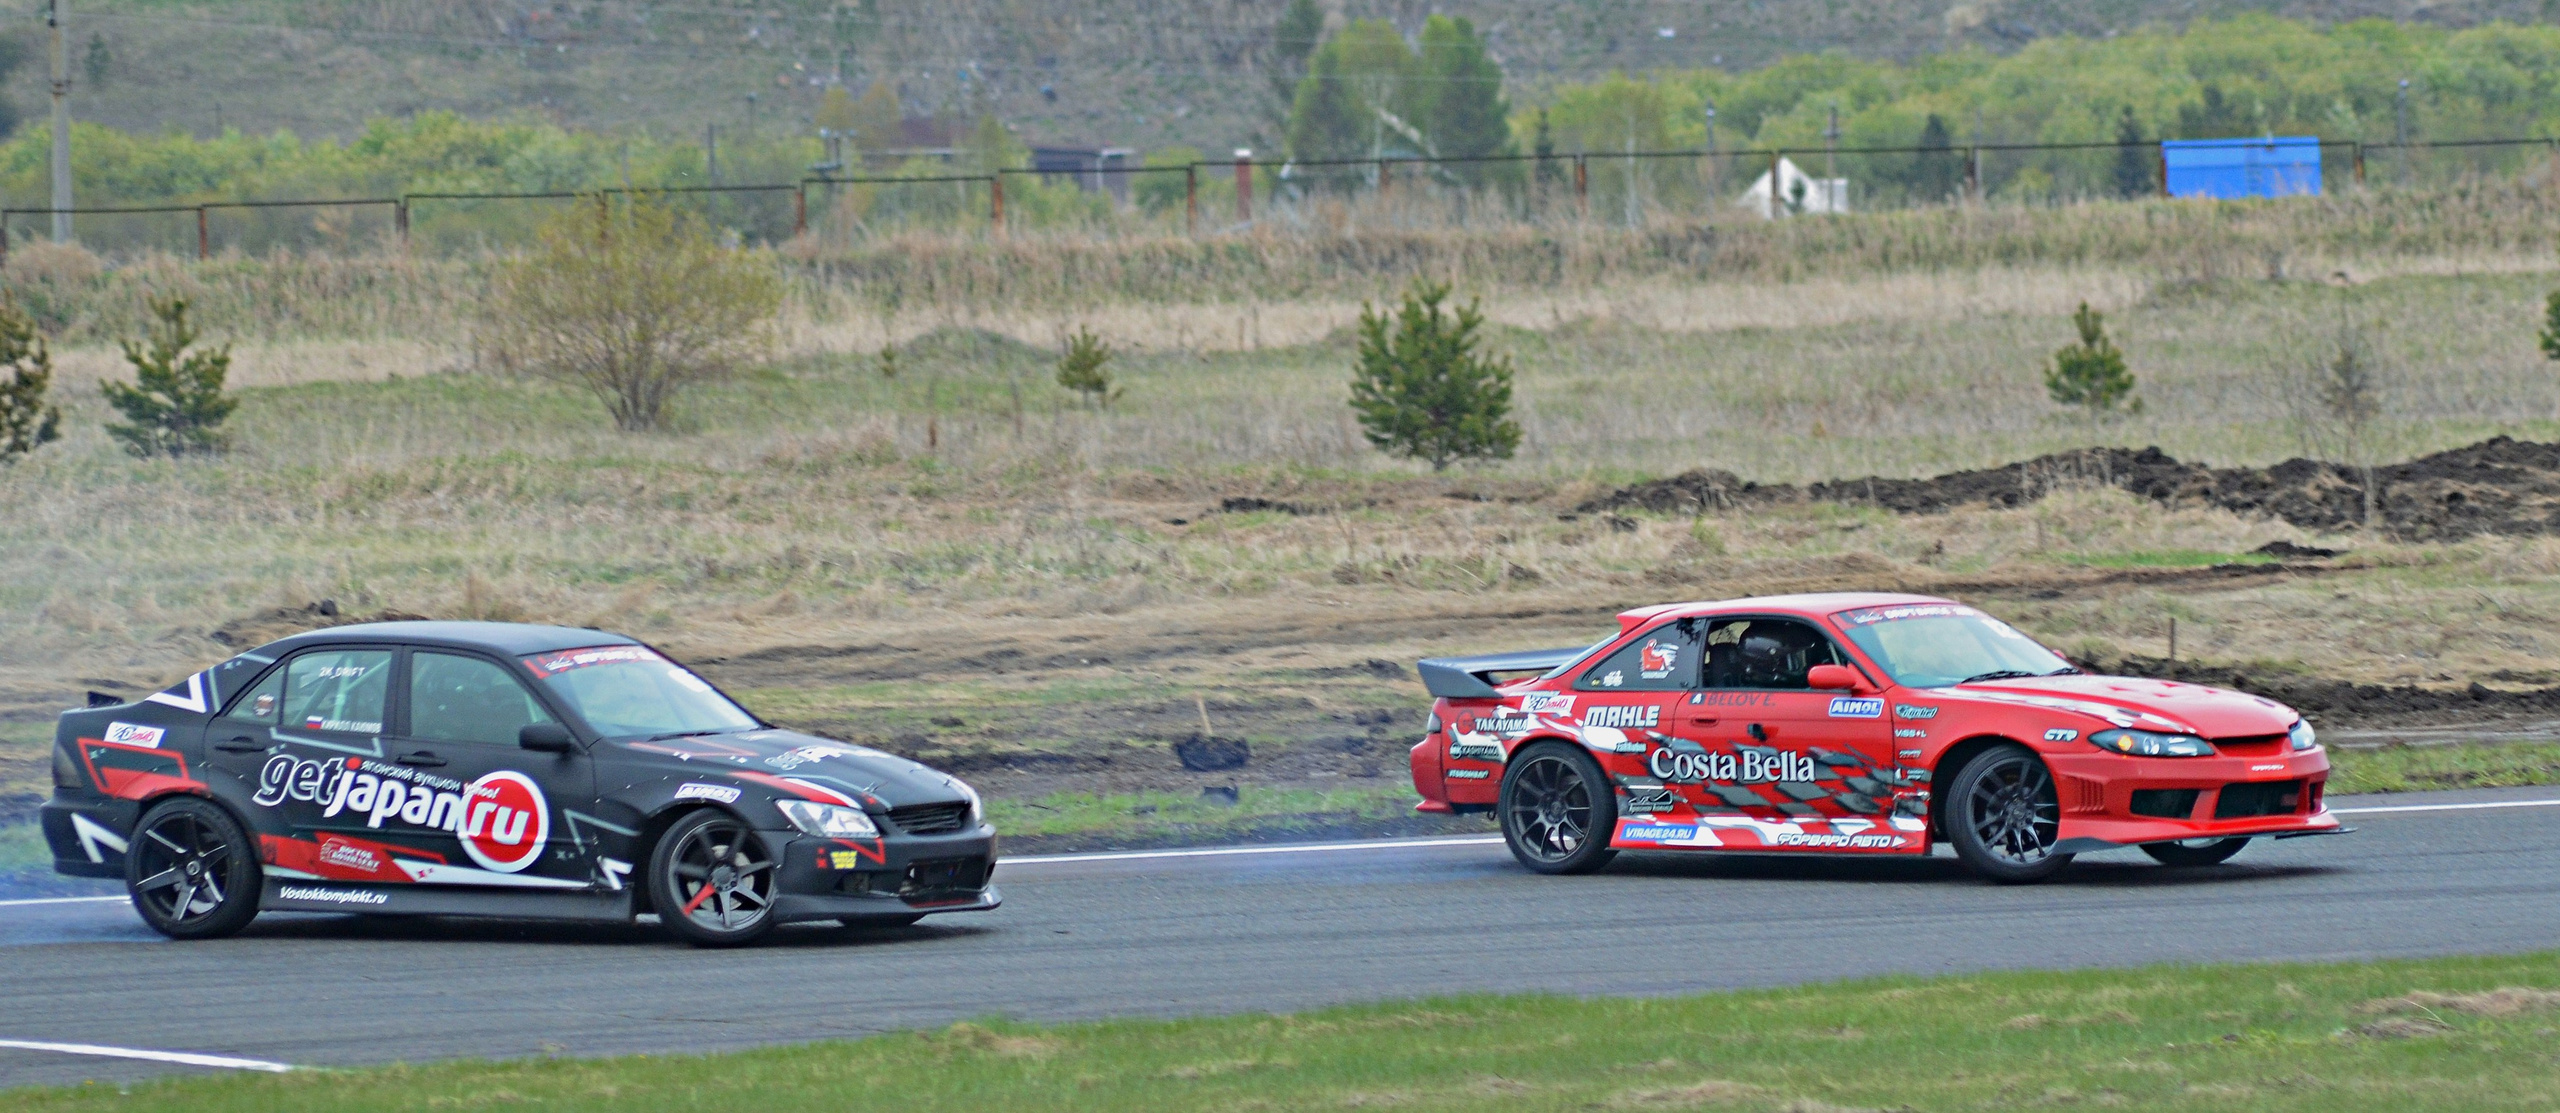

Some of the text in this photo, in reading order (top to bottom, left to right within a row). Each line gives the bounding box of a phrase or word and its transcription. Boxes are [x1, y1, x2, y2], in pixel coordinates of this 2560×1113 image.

[1708, 692, 1761, 706] BELOV
[1832, 701, 1880, 713] AIMOL
[1584, 705, 1660, 728] MAHLE
[1475, 718, 1528, 732] TAKAYAMA
[1651, 746, 1816, 782] Costa Bella
[1625, 827, 1693, 839] VIRAGE24.RU
[280, 886, 388, 904] Vostokkomplekt.ru
